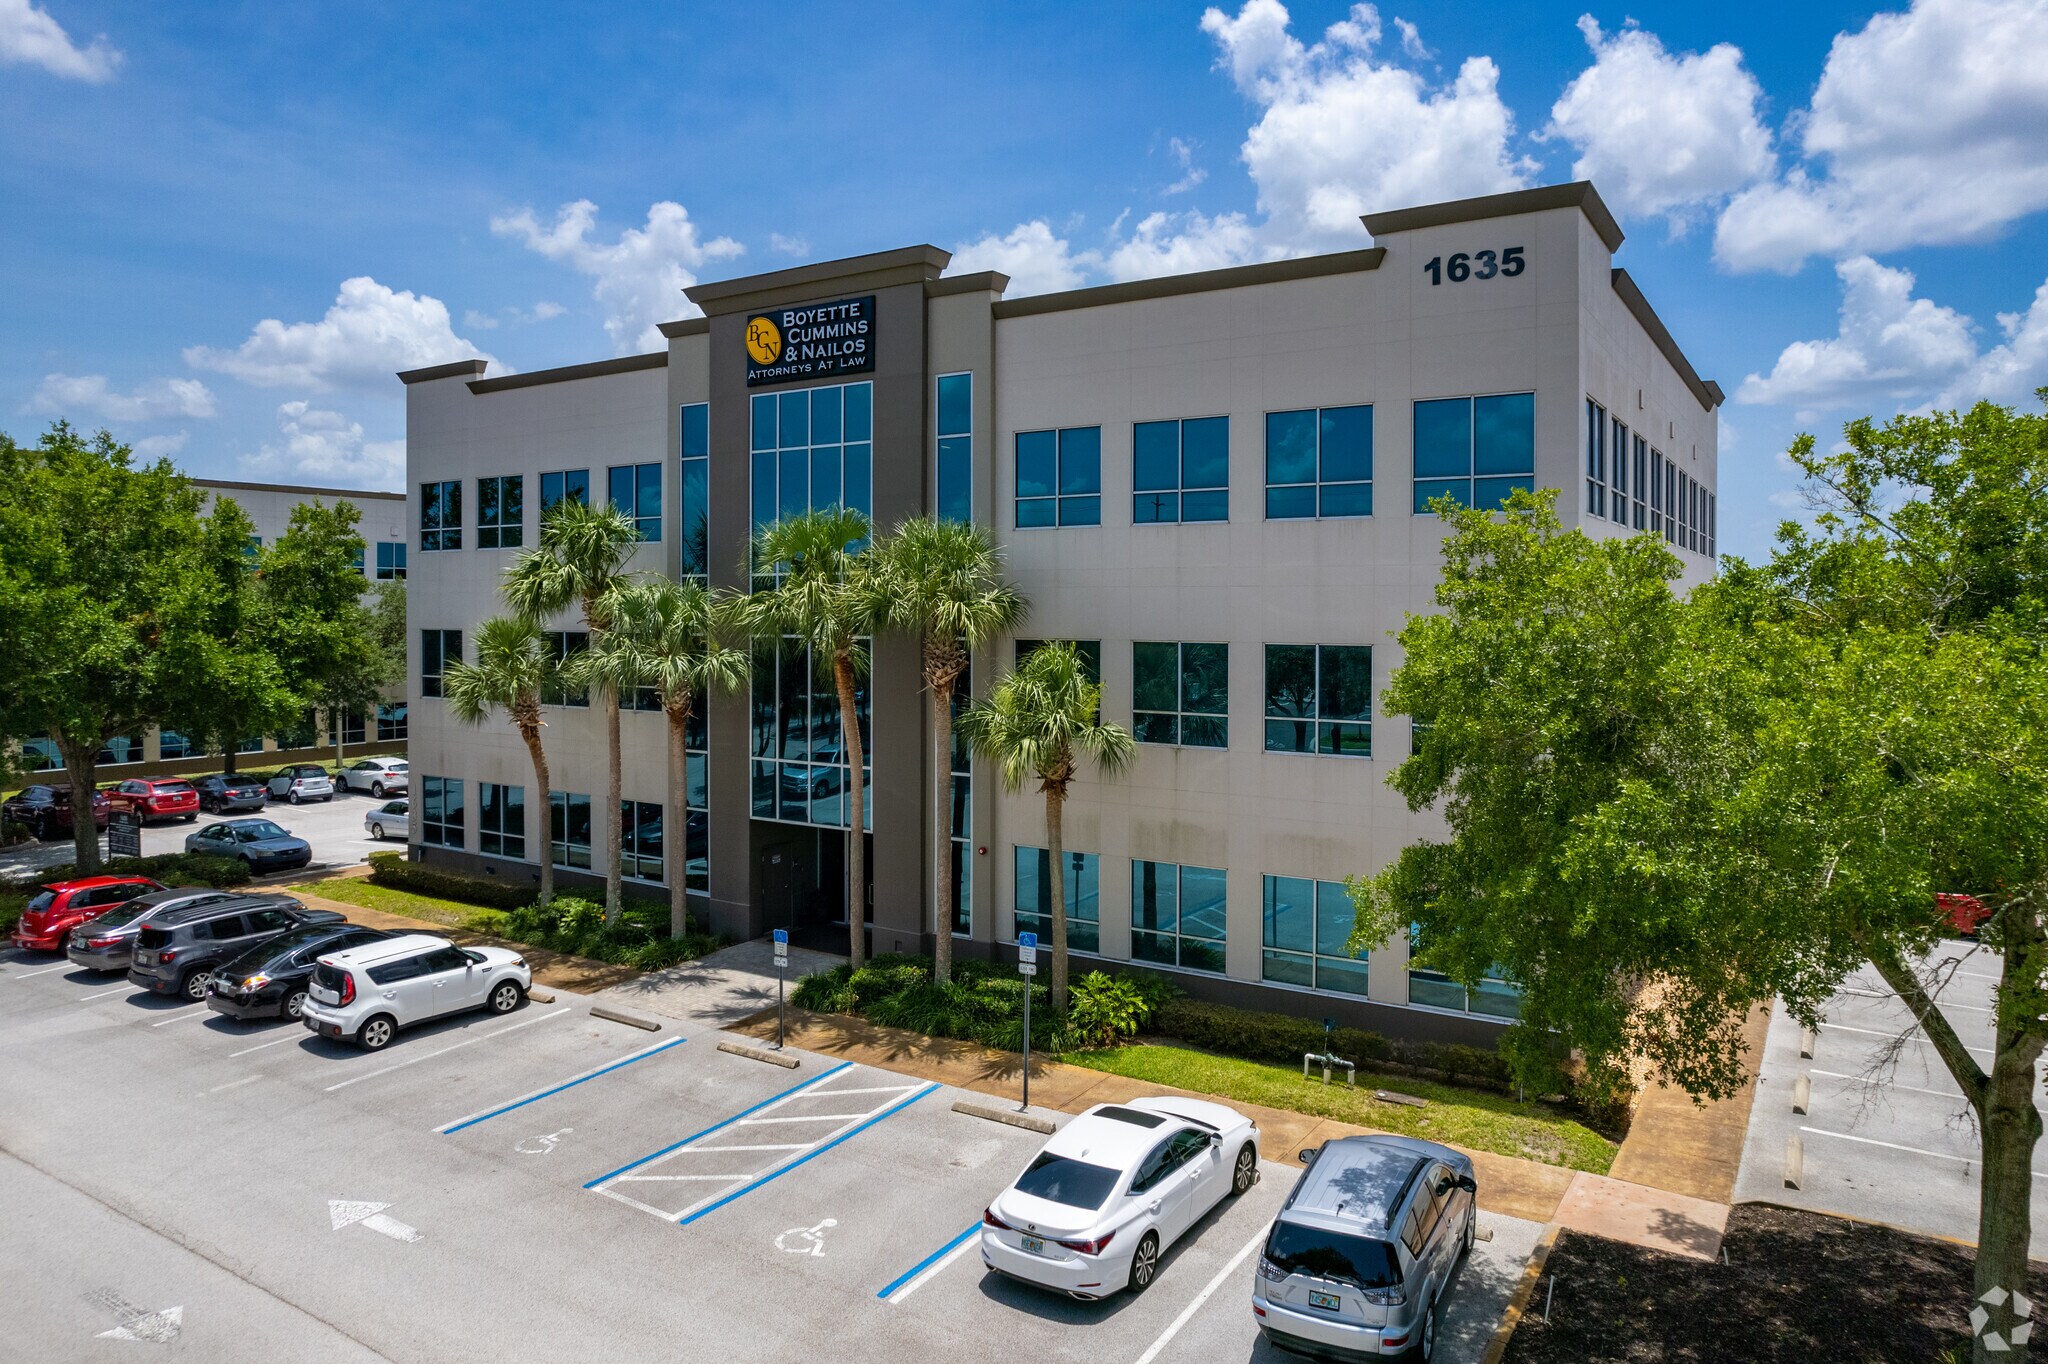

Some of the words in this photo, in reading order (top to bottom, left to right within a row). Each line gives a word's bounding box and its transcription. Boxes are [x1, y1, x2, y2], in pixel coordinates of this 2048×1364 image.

[1424, 246, 1526, 286] 1635
[783, 302, 860, 327] BOYETTE
[787, 320, 868, 343] CUMMINS
[785, 346, 798, 362] &
[802, 339, 866, 360] NAILOS
[748, 363, 812, 379] ATTORNEYS
[818, 360, 833, 371] AT
[840, 356, 866, 368] LAW
